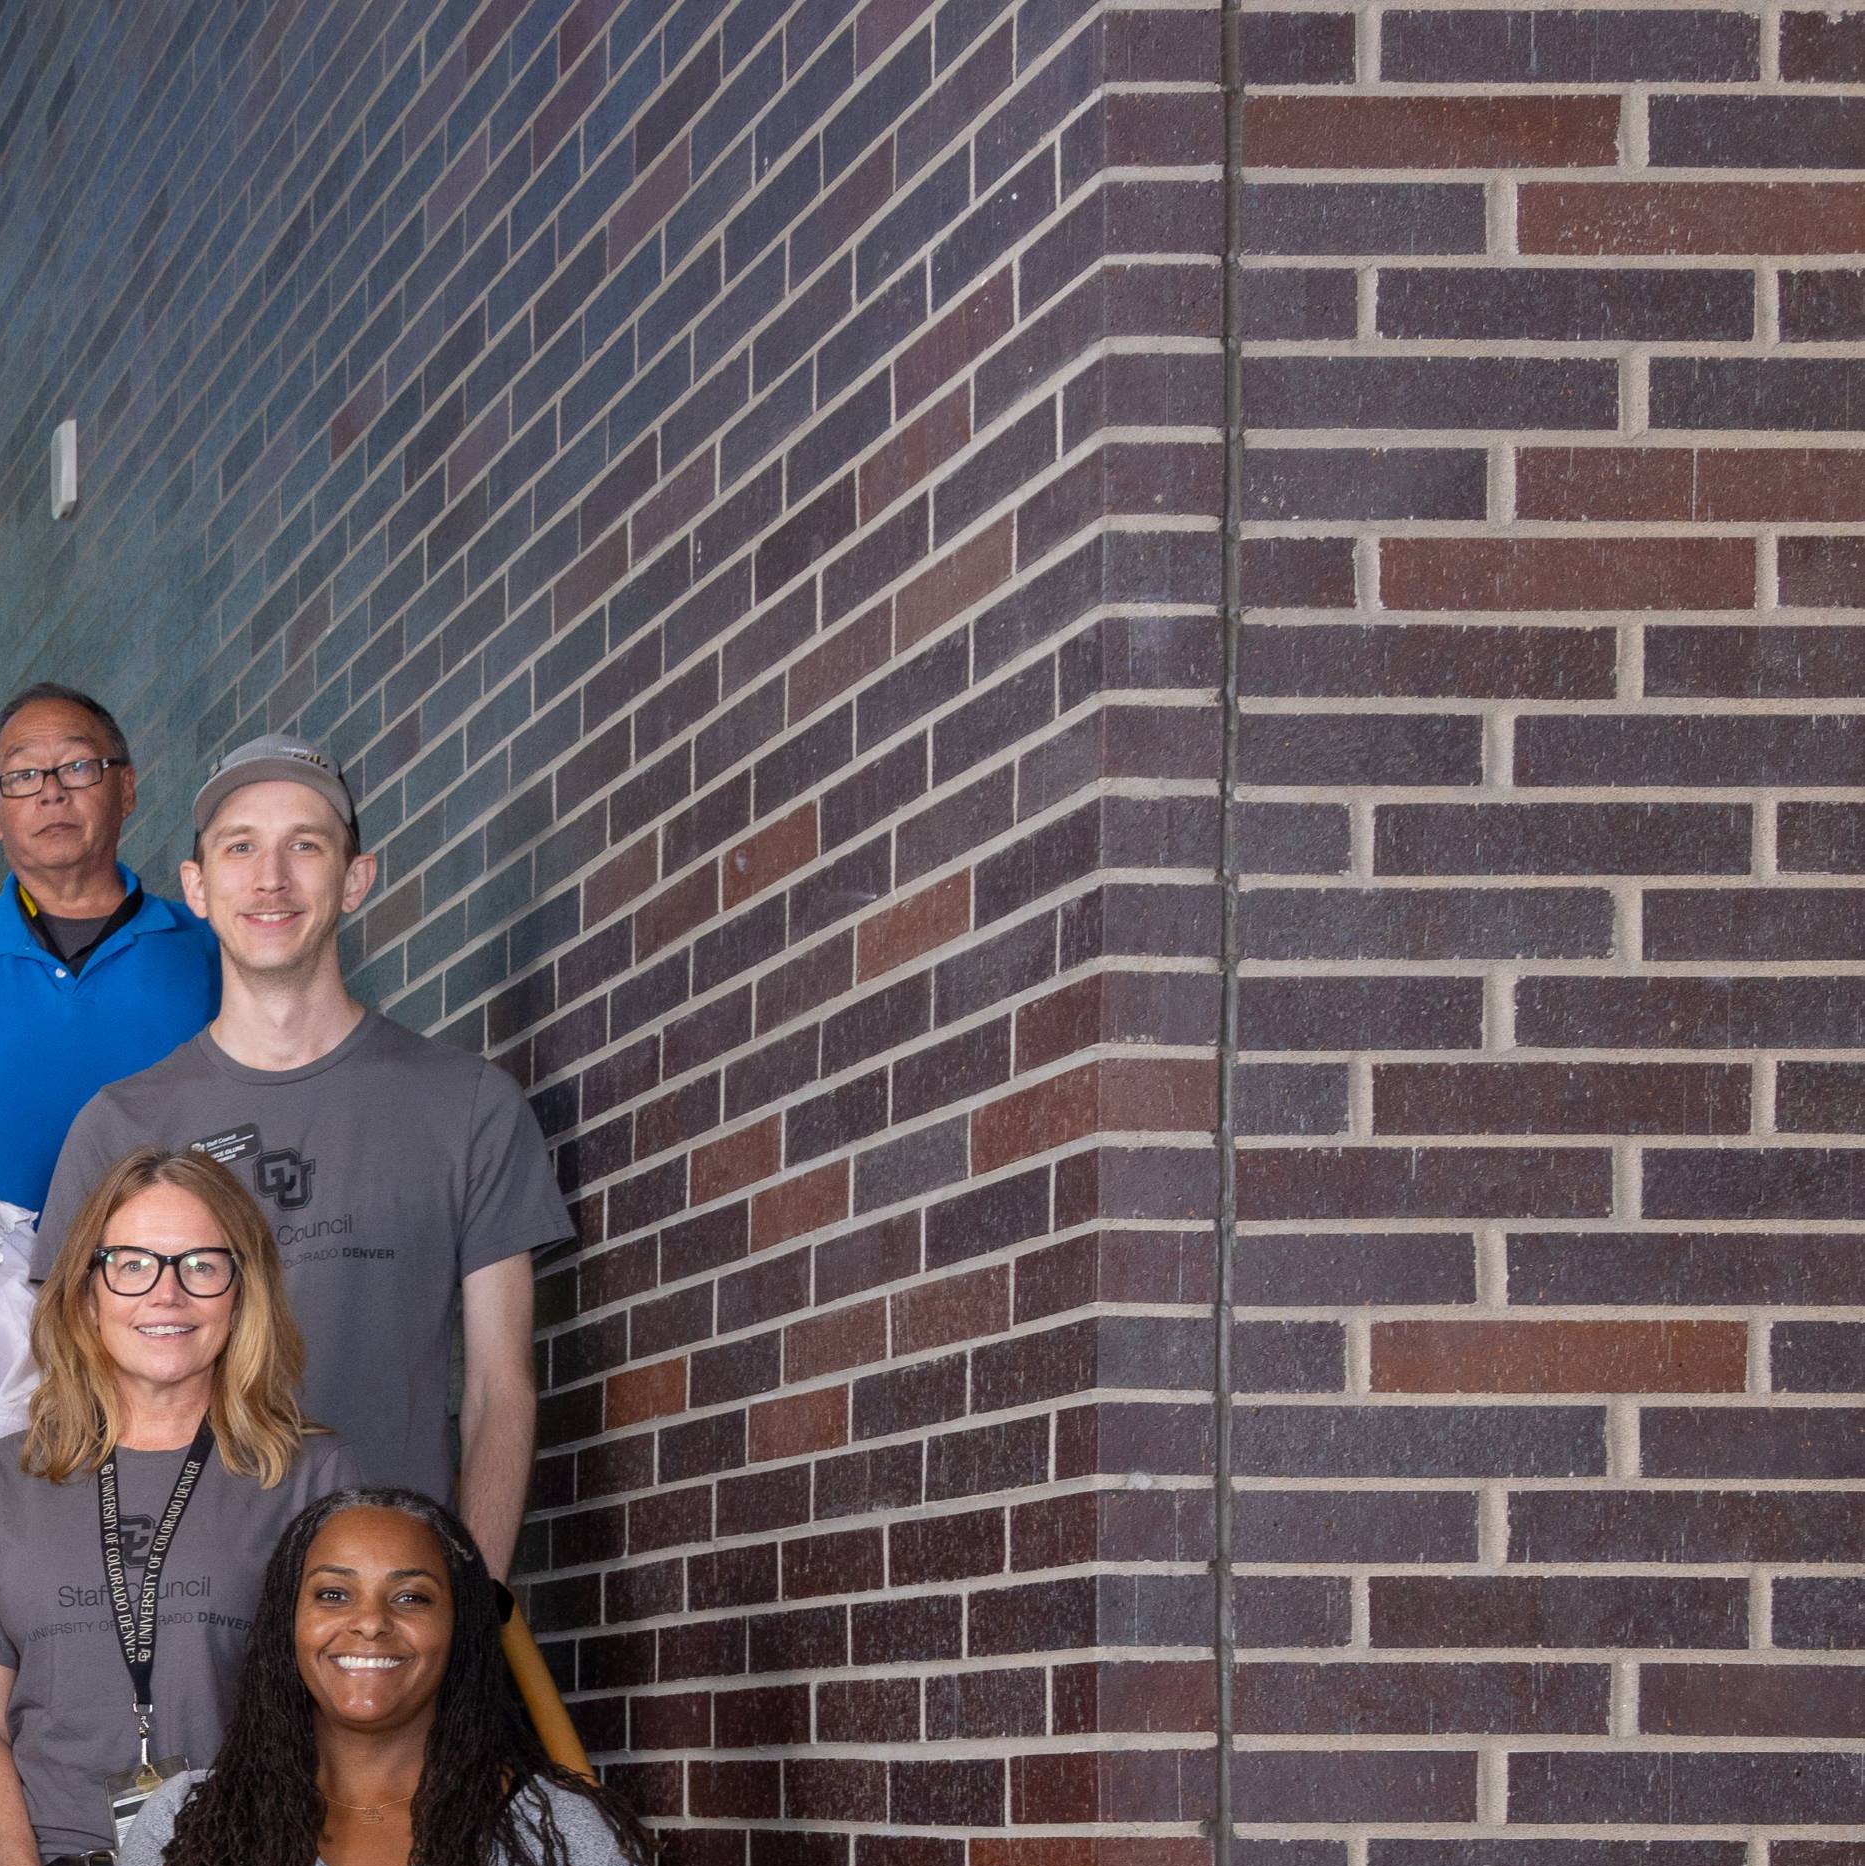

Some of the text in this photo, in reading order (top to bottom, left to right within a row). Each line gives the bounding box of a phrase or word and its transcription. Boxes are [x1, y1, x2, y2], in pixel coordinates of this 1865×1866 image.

[253, 1147, 316, 1211] CU
[277, 1214, 352, 1246] Council
[283, 1248, 395, 1269] OLORADO DENVER
[174, 1460, 202, 1500] DENVER
[101, 1476, 119, 1531] UNIVERSITY
[104, 1532, 119, 1546] OF
[152, 1498, 185, 1552] COLORADO
[148, 1553, 163, 1569] OF
[58, 1576, 211, 1608] Staf Cuncil
[105, 1547, 130, 1612] COLORADO
[27, 1620, 94, 1642] UNIVERSITY
[158, 1612, 193, 1625] RADO
[197, 1611, 253, 1632] DENVER
[138, 1573, 158, 1645] UNIVERSITY
